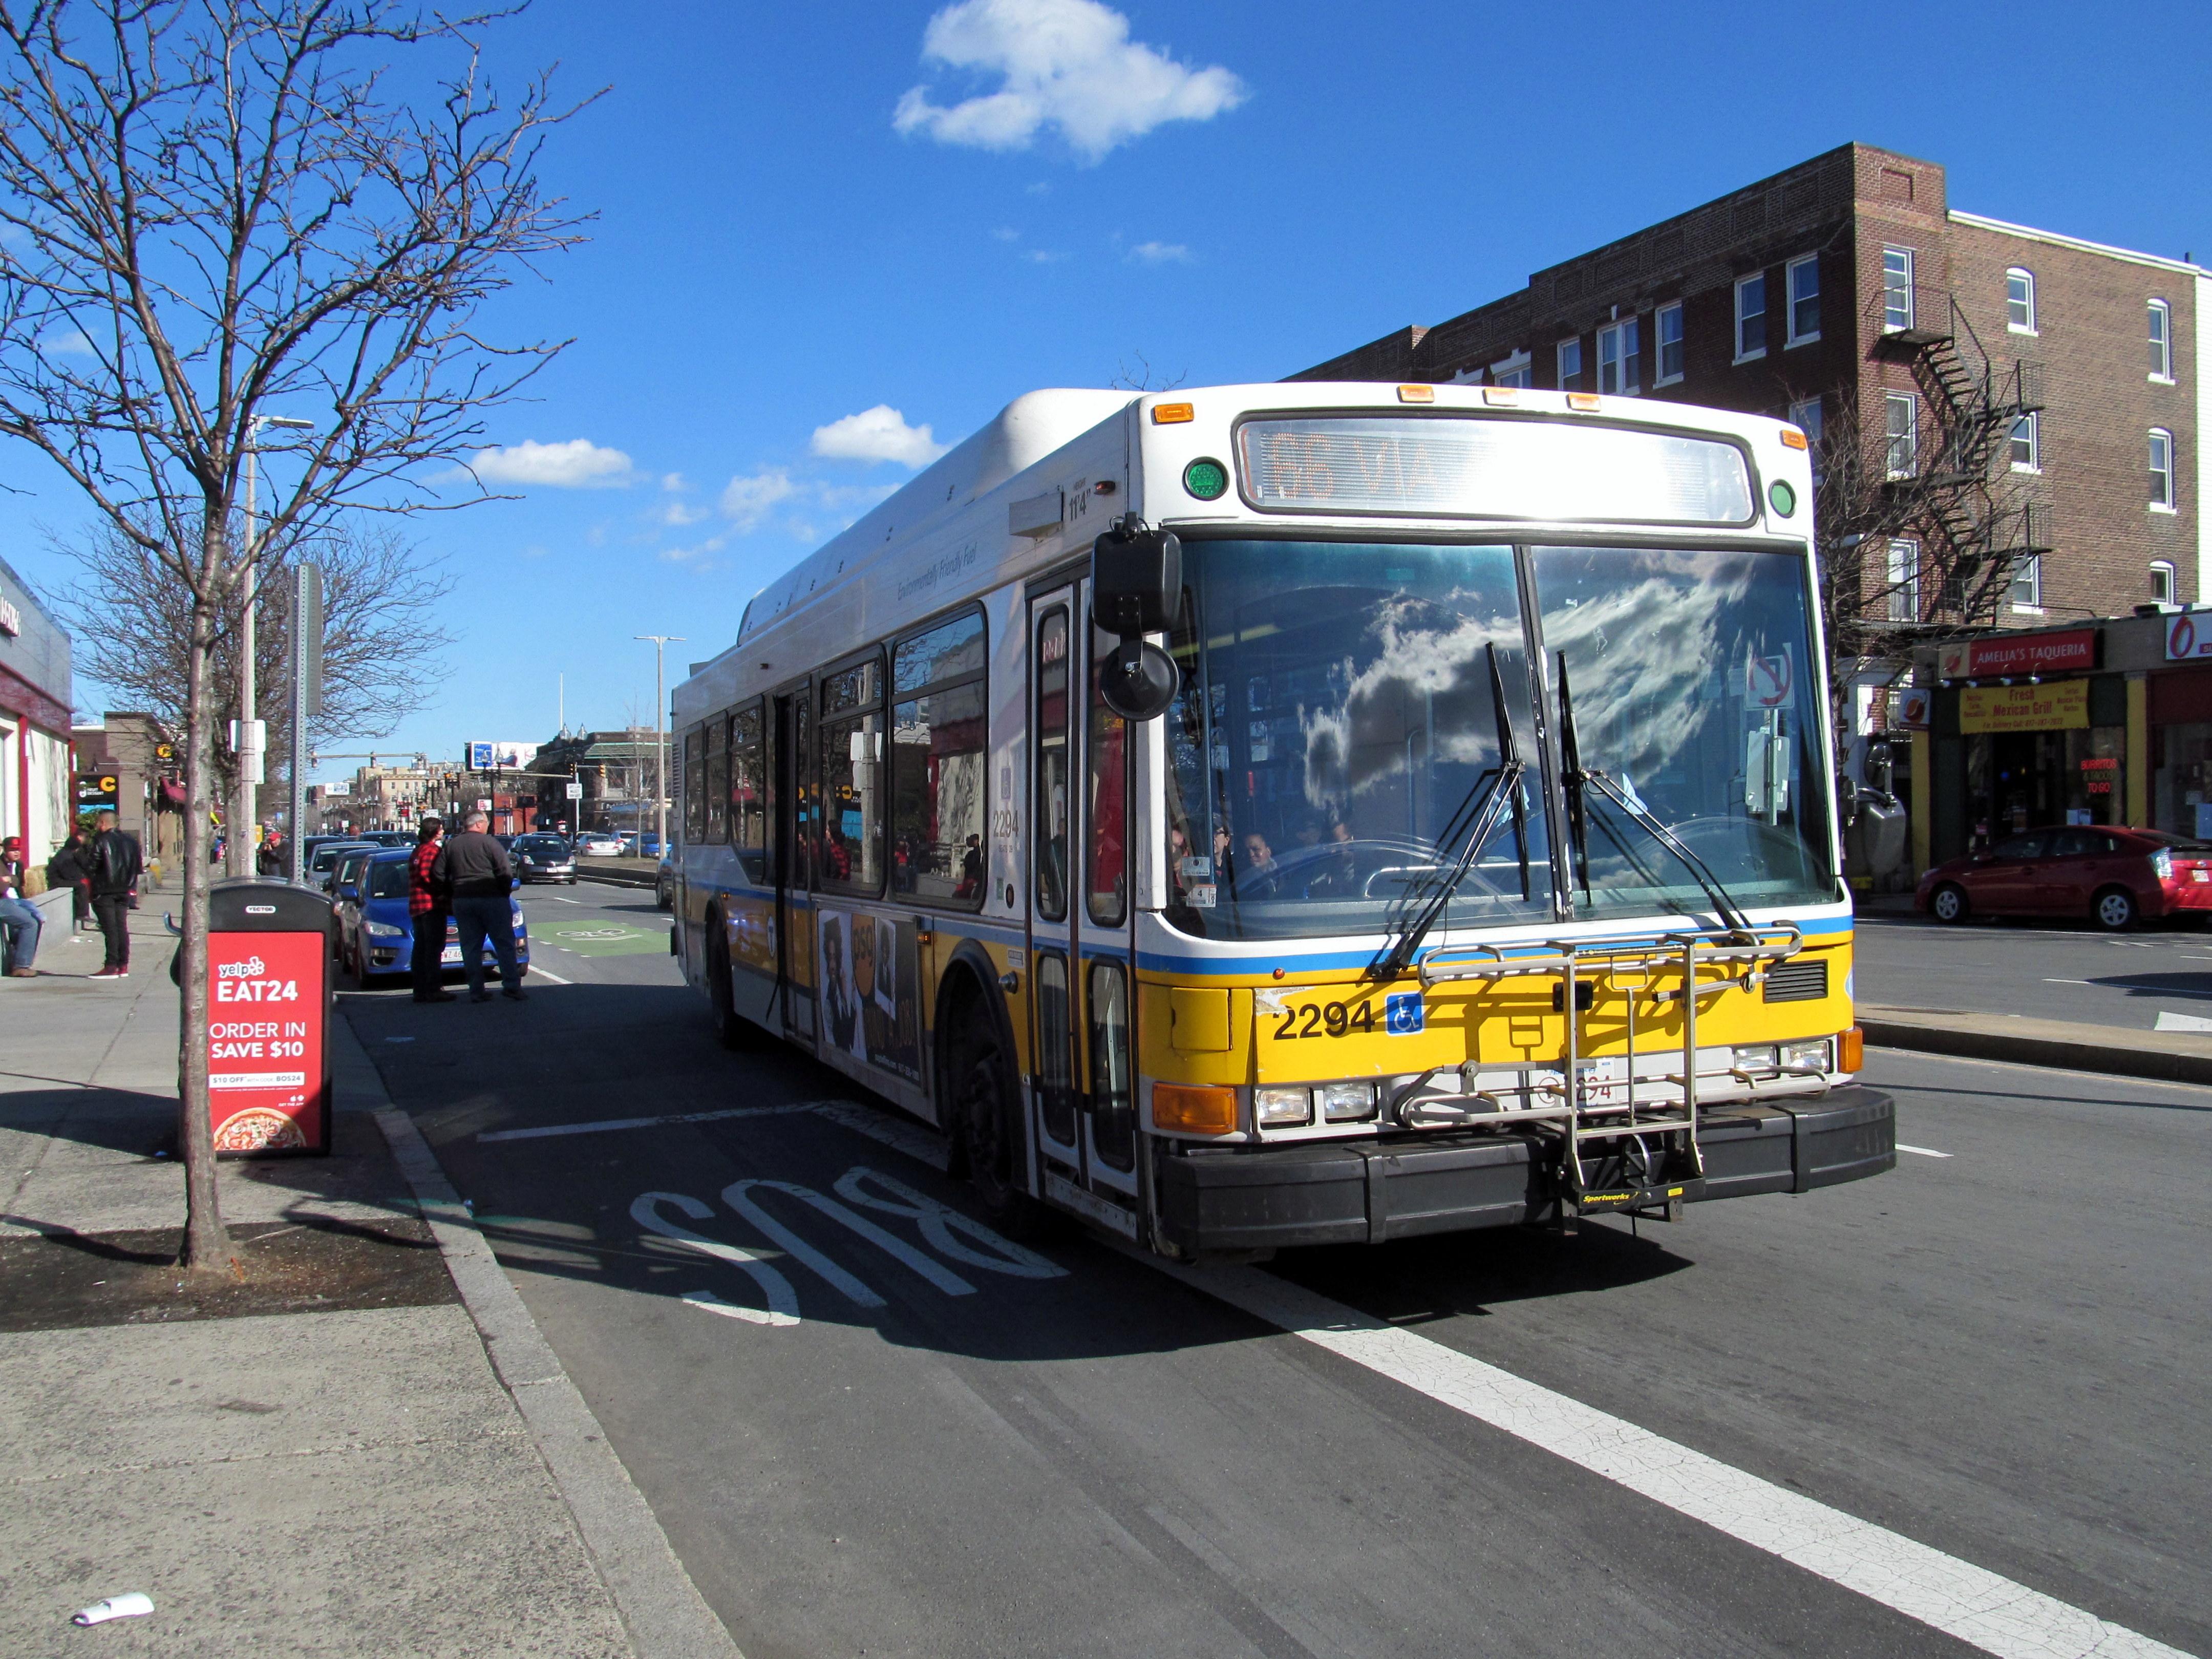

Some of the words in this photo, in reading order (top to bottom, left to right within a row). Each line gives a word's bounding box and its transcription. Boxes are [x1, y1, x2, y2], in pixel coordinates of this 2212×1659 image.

[963, 541, 977, 566] Fuel
[1977, 649, 2025, 663] AMELIA'S
[2030, 643, 2086, 660] TAQUERIA
[2010, 689, 2035, 701] Fresh
[1993, 704, 2029, 717] Mexican
[2033, 701, 2052, 715] Grill
[2089, 783, 2098, 793] TO
[2099, 782, 2110, 792] GO
[993, 810, 1019, 838] 2294
[219, 962, 250, 977] yelp
[218, 980, 298, 1002] EAT24
[1273, 1000, 1375, 1040] 2294
[209, 1023, 279, 1038] ORDER
[285, 1022, 305, 1037] IN
[211, 1042, 263, 1058] SAVE
[270, 1041, 304, 1058] $10
[1583, 1194, 1630, 1203] Sportworks
[629, 1165, 1072, 1327] BUS
